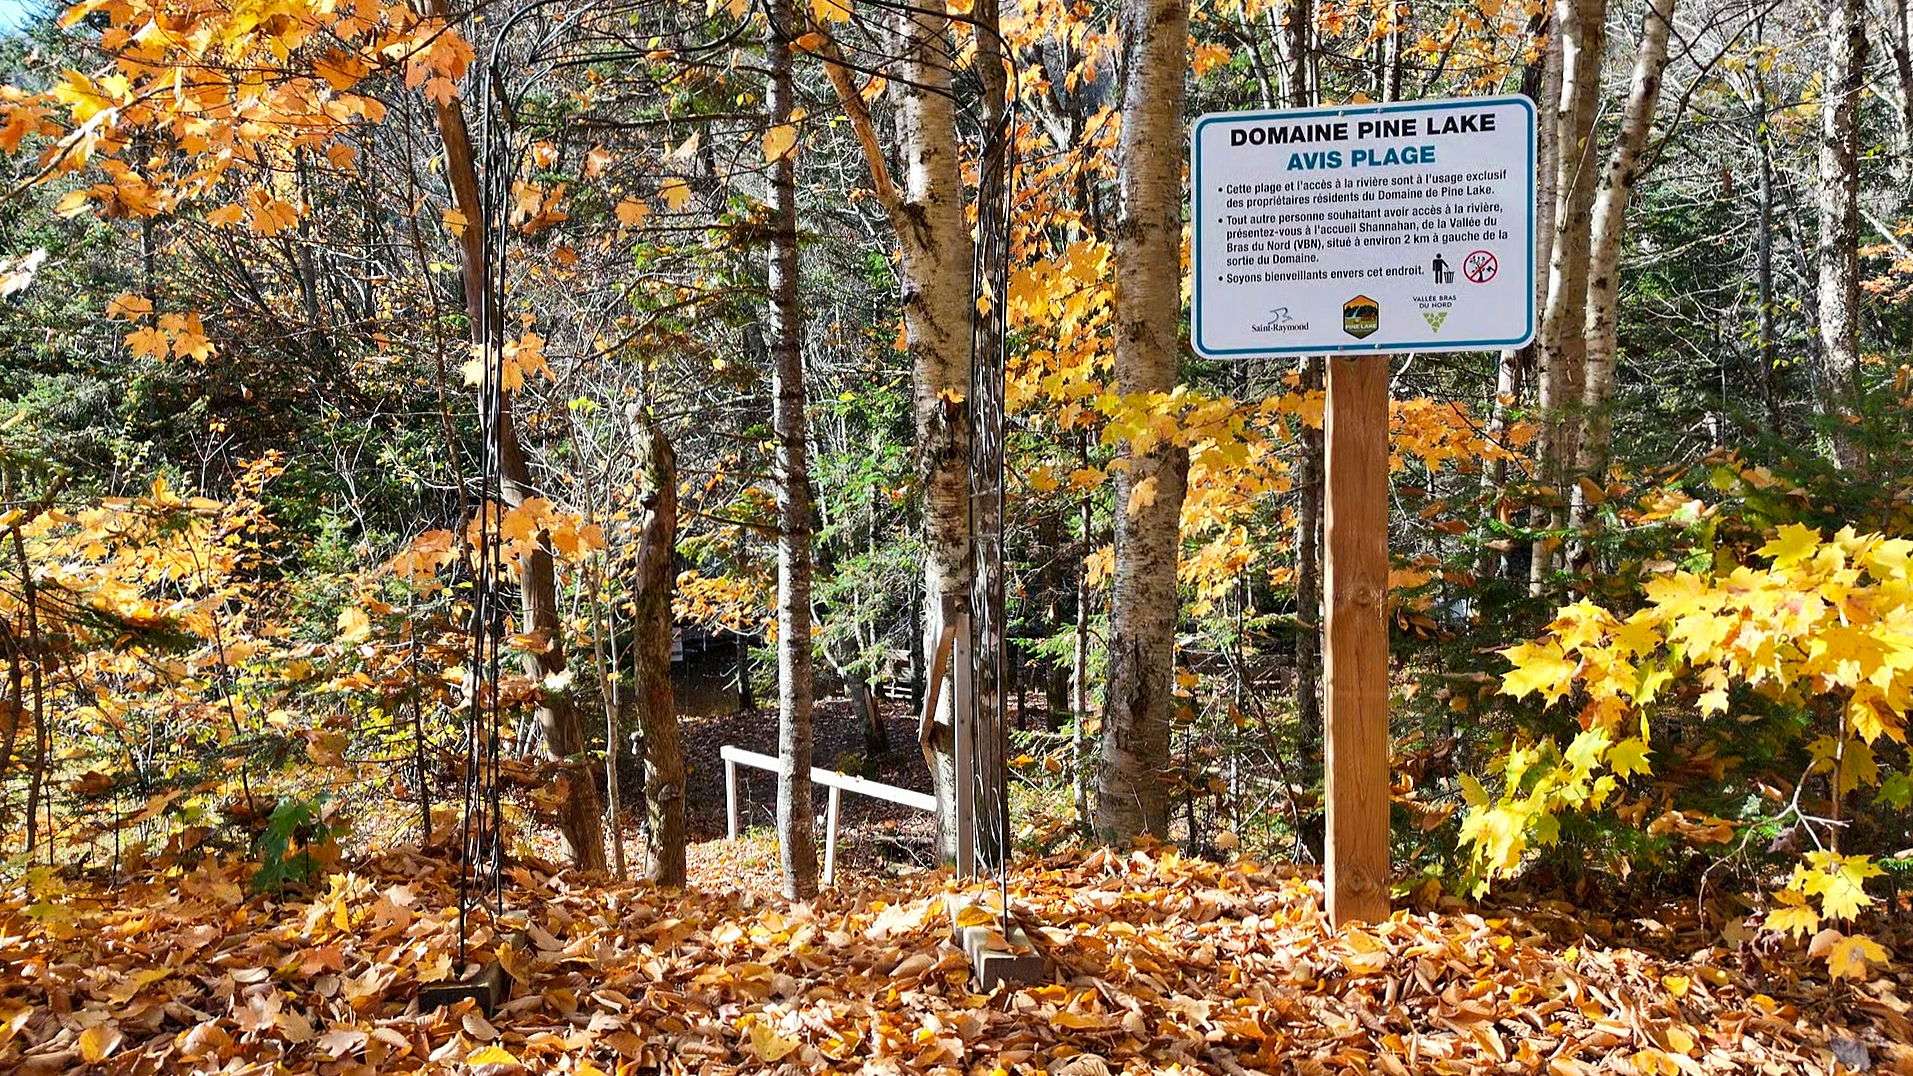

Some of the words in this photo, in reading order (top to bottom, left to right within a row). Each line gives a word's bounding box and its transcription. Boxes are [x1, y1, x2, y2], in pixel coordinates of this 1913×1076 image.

[1231, 122, 1349, 147] DOMAINE
[1358, 118, 1417, 140] PINE
[1427, 113, 1496, 136] LAKE
[1286, 150, 1343, 171] AVIS
[1351, 144, 1436, 168] PLAGE
[1226, 183, 1252, 195] Cette
[1255, 182, 1282, 195] plage
[1284, 181, 1294, 192] et
[1297, 178, 1332, 191] l'accès
[1335, 178, 1341, 189] à
[1344, 178, 1353, 189] la
[1356, 176, 1388, 188] rivière
[1391, 175, 1414, 186] sont
[1416, 173, 1422, 185] à
[1426, 173, 1463, 185] l'usage
[1466, 168, 1507, 182] exclusif
[1226, 198, 1244, 209] des
[1247, 194, 1310, 209] propriétaires
[1313, 191, 1359, 204] résidents
[1362, 190, 1375, 202] du
[1378, 188, 1423, 201] Domaine
[1426, 187, 1438, 198] de
[1441, 186, 1464, 197] Pine
[1467, 184, 1495, 196] Lake.
[1226, 214, 1247, 226] Tout
[1250, 213, 1276, 225] autre
[1278, 212, 1325, 225] personne
[1327, 207, 1381, 221] souhaitant
[1384, 206, 1409, 218] avoir
[1412, 204, 1442, 217] accès
[1445, 203, 1451, 215] à
[1454, 203, 1464, 214] la
[1467, 201, 1503, 214] rivière,
[1227, 228, 1302, 241] présentez-vous
[1305, 224, 1311, 236] à
[1314, 222, 1356, 235] l'accueil
[1359, 220, 1419, 233] Shannahan,
[1422, 218, 1434, 230] de
[1437, 218, 1446, 229] la
[1449, 216, 1481, 228] Vallée
[1484, 216, 1497, 227] du
[1227, 242, 1249, 253] Bras
[1252, 241, 1264, 252] du
[1267, 239, 1290, 251] Nord
[1294, 238, 1324, 252] (VBN),
[1327, 236, 1352, 248] situé
[1354, 236, 1360, 247] à
[1363, 235, 1401, 247] environ
[1404, 233, 1410, 245] 2
[1413, 231, 1430, 244] km
[1433, 232, 1439, 243] à
[1442, 230, 1480, 245] gauche
[1483, 230, 1495, 241] de
[1498, 229, 1508, 240] la
[1226, 255, 1255, 267] sortie
[1257, 254, 1270, 266] du
[1273, 252, 1319, 264] Domaine.
[1227, 273, 1262, 285] Soyons
[1265, 269, 1328, 282] bienveillants
[1330, 269, 1364, 279] envers
[1367, 266, 1383, 278] cet
[1385, 264, 1424, 277] endroit.
[1419, 302, 1429, 310] DU
[1431, 301, 1452, 309] NORD
[1439, 294, 1457, 302] BRAS
[1251, 322, 1309, 334] Saint-Raymond
